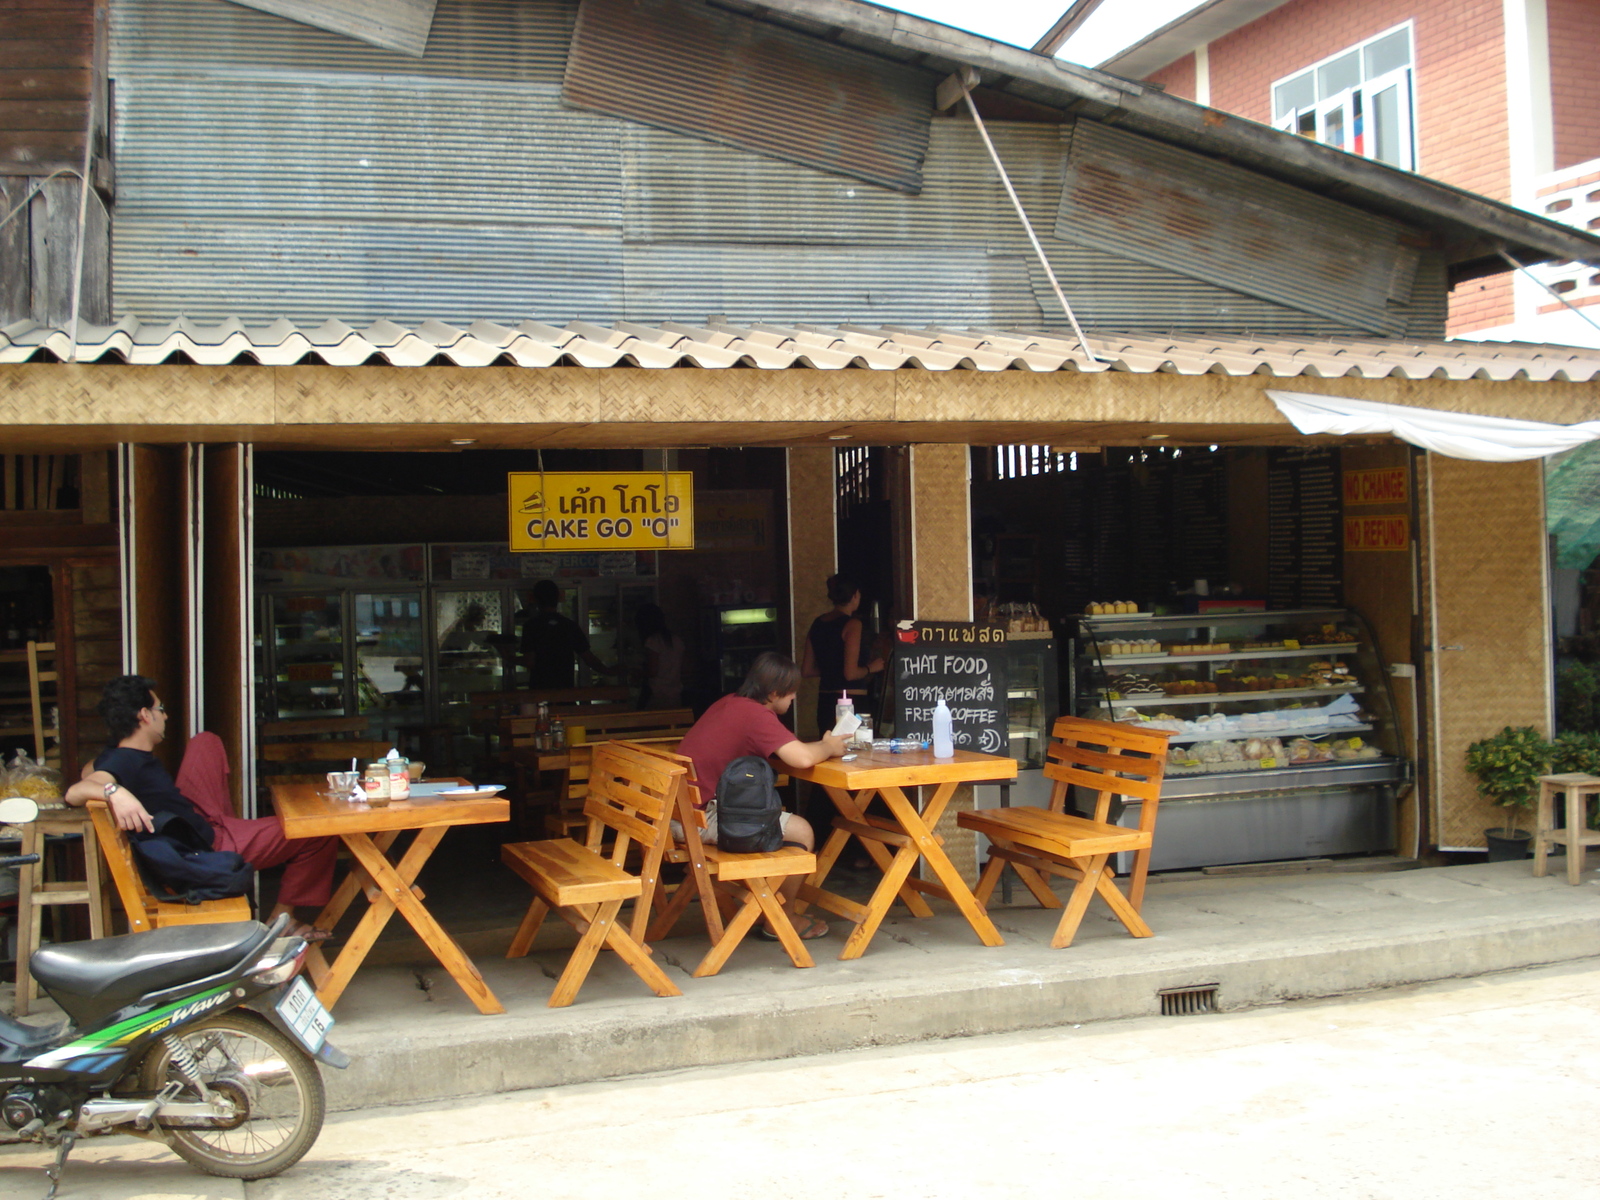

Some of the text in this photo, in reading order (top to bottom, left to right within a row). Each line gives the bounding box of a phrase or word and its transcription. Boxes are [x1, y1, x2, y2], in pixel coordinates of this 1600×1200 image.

[1345, 471, 1404, 500] NO CHANGE
[559, 484, 680, 515] เค้ก โกโอ
[527, 518, 589, 539] CAKE
[596, 518, 633, 538] GO
[642, 517, 679, 538] "O"
[1345, 519, 1405, 546] NO REFUND
[921, 625, 1005, 643] กาแฟสด
[901, 654, 988, 675] THAI FOOD
[951, 707, 998, 724] COFFEE
[150, 990, 232, 1034] 100 Wave
[311, 1017, 325, 1037] 16
